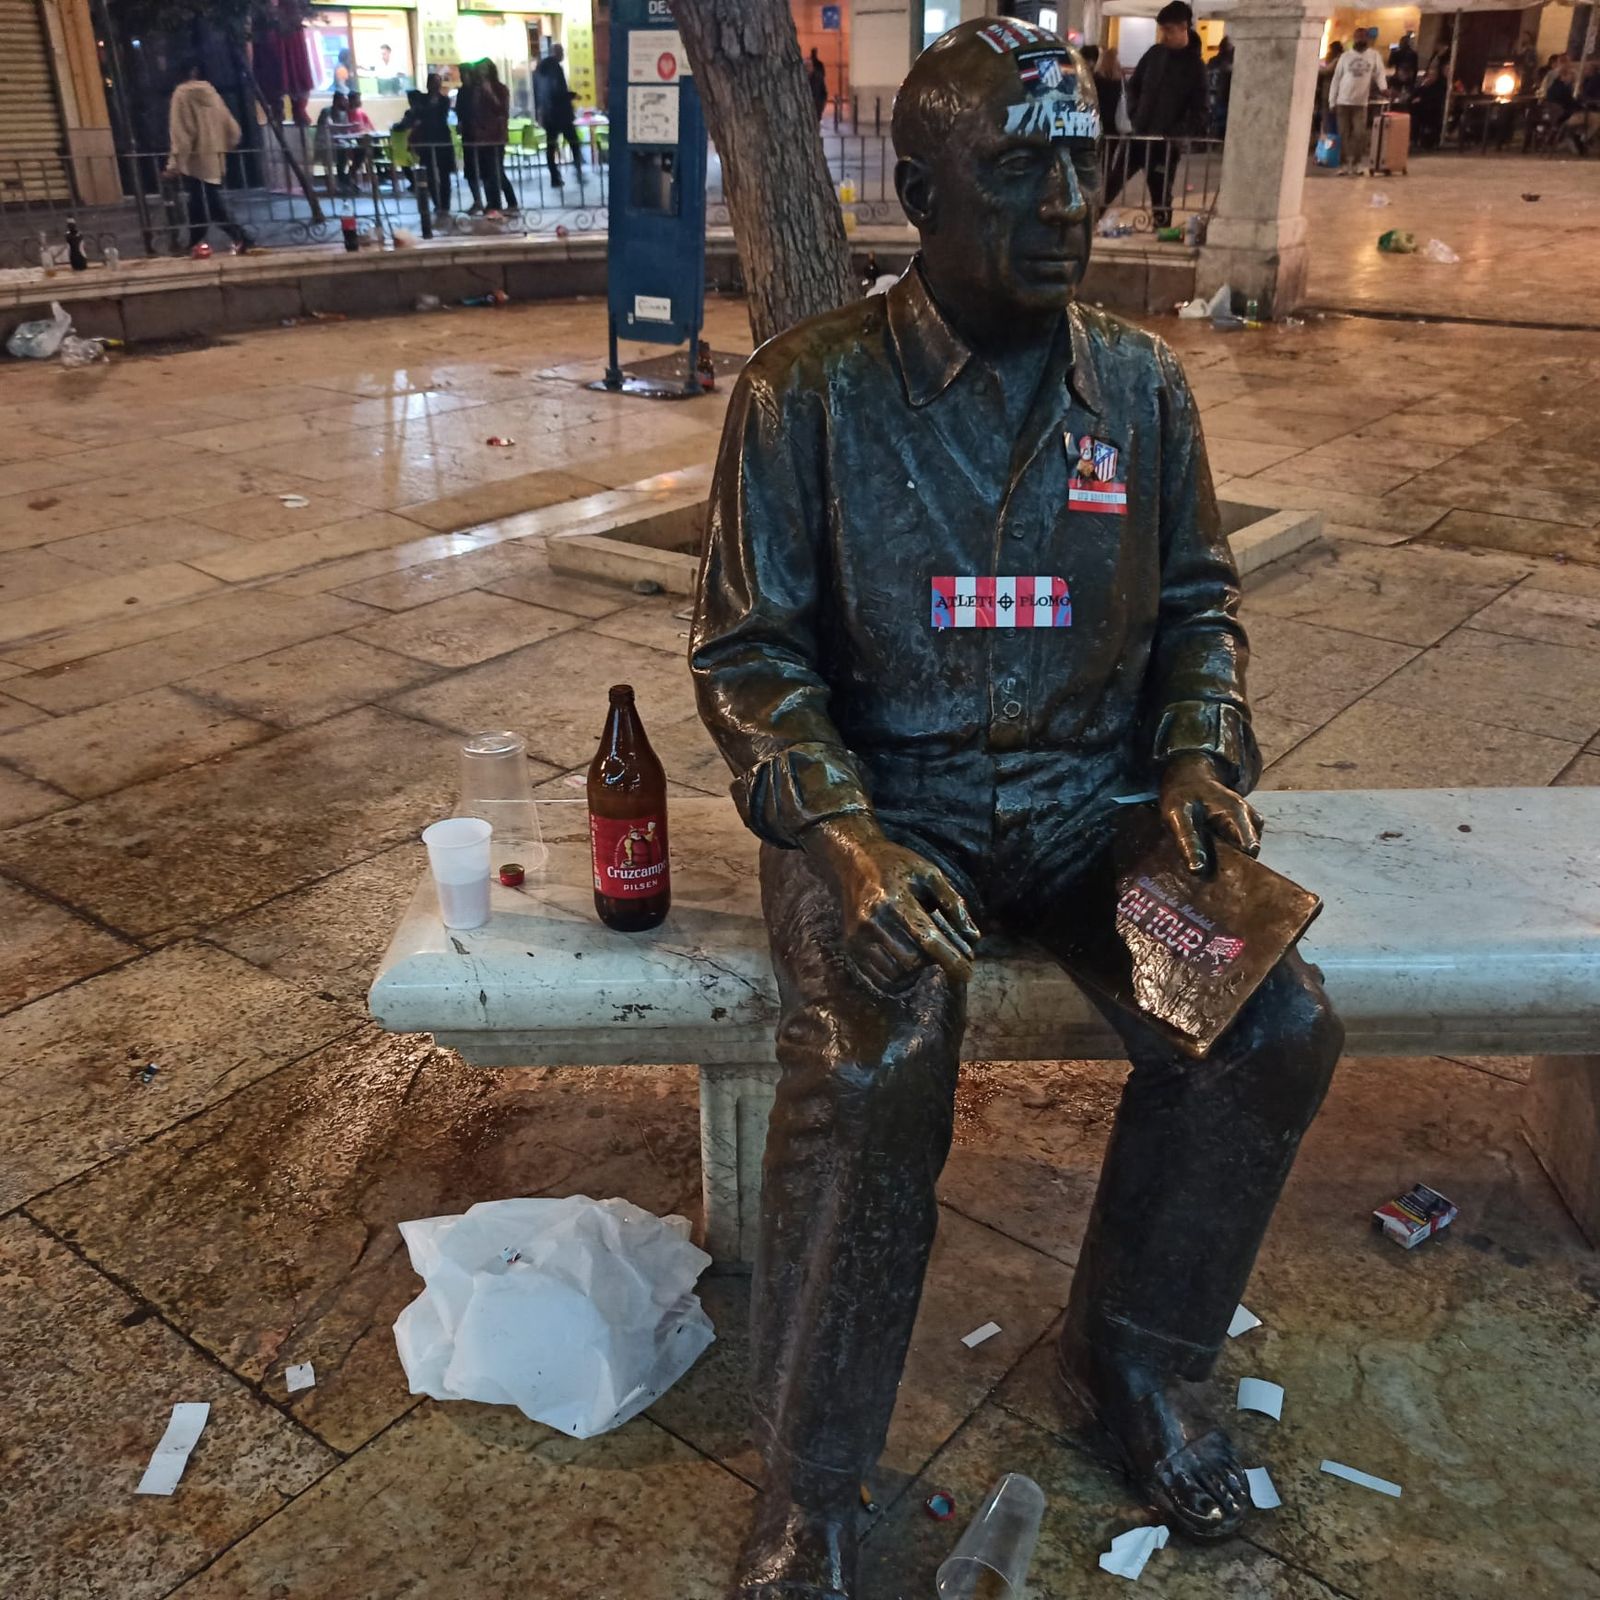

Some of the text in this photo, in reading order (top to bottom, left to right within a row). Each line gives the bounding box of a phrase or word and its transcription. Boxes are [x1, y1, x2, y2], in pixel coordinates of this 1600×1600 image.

[935, 593, 994, 610] ATLETI
[623, 879, 658, 891] PILSEN
[1116, 887, 1204, 957] ON TOUR
